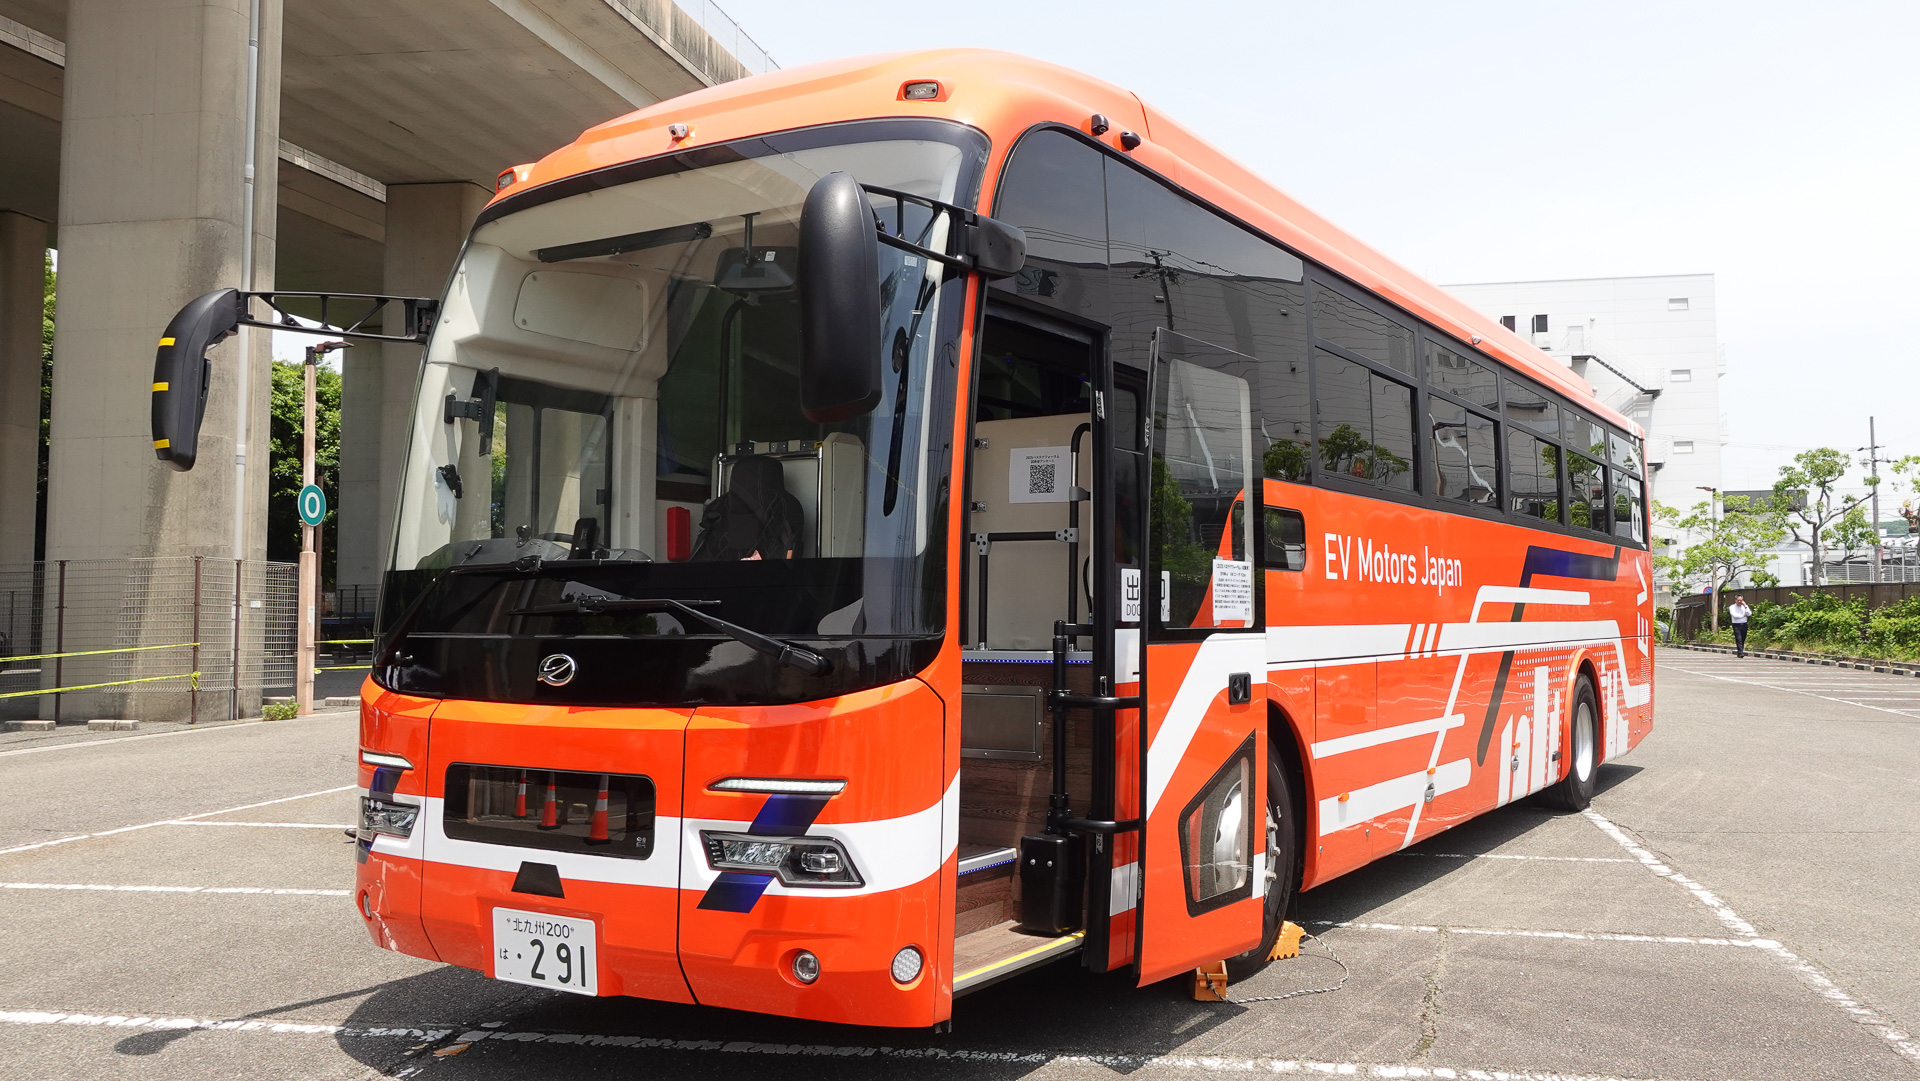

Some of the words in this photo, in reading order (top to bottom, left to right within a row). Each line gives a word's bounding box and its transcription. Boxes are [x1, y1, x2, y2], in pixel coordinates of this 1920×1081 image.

[1324, 532, 1352, 581] EV
[1357, 536, 1417, 585] Motors
[1420, 545, 1462, 597] Japan
